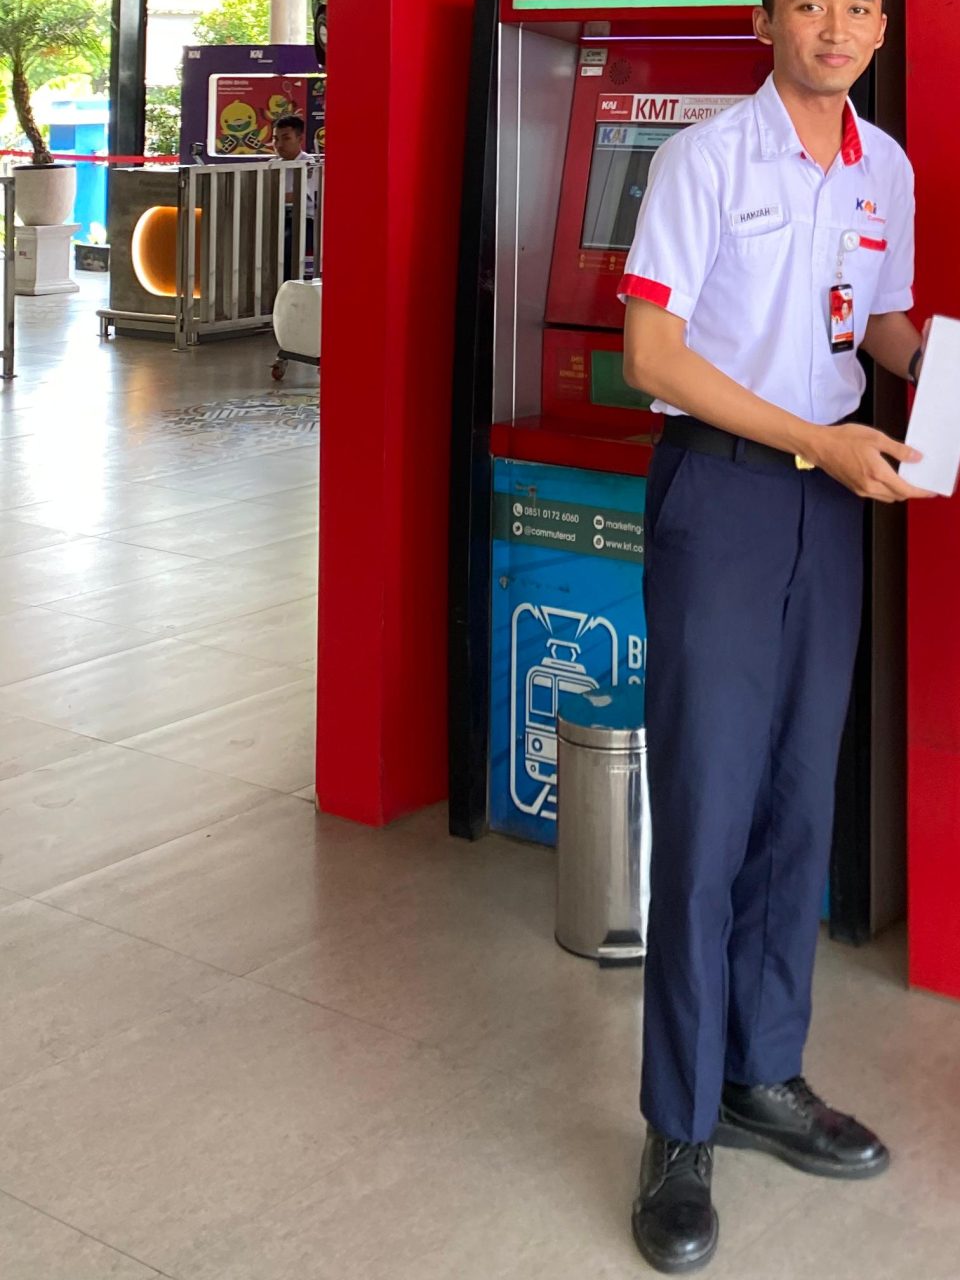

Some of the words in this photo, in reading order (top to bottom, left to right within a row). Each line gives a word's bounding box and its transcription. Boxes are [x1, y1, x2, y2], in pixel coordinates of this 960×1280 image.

[601, 101, 617, 110] KAI
[635, 98, 680, 121] KMT
[740, 207, 771, 223] HAMZAH
[524, 506, 541, 517] 0851
[542, 509, 561, 521] 0172
[561, 512, 580, 524] 6060
